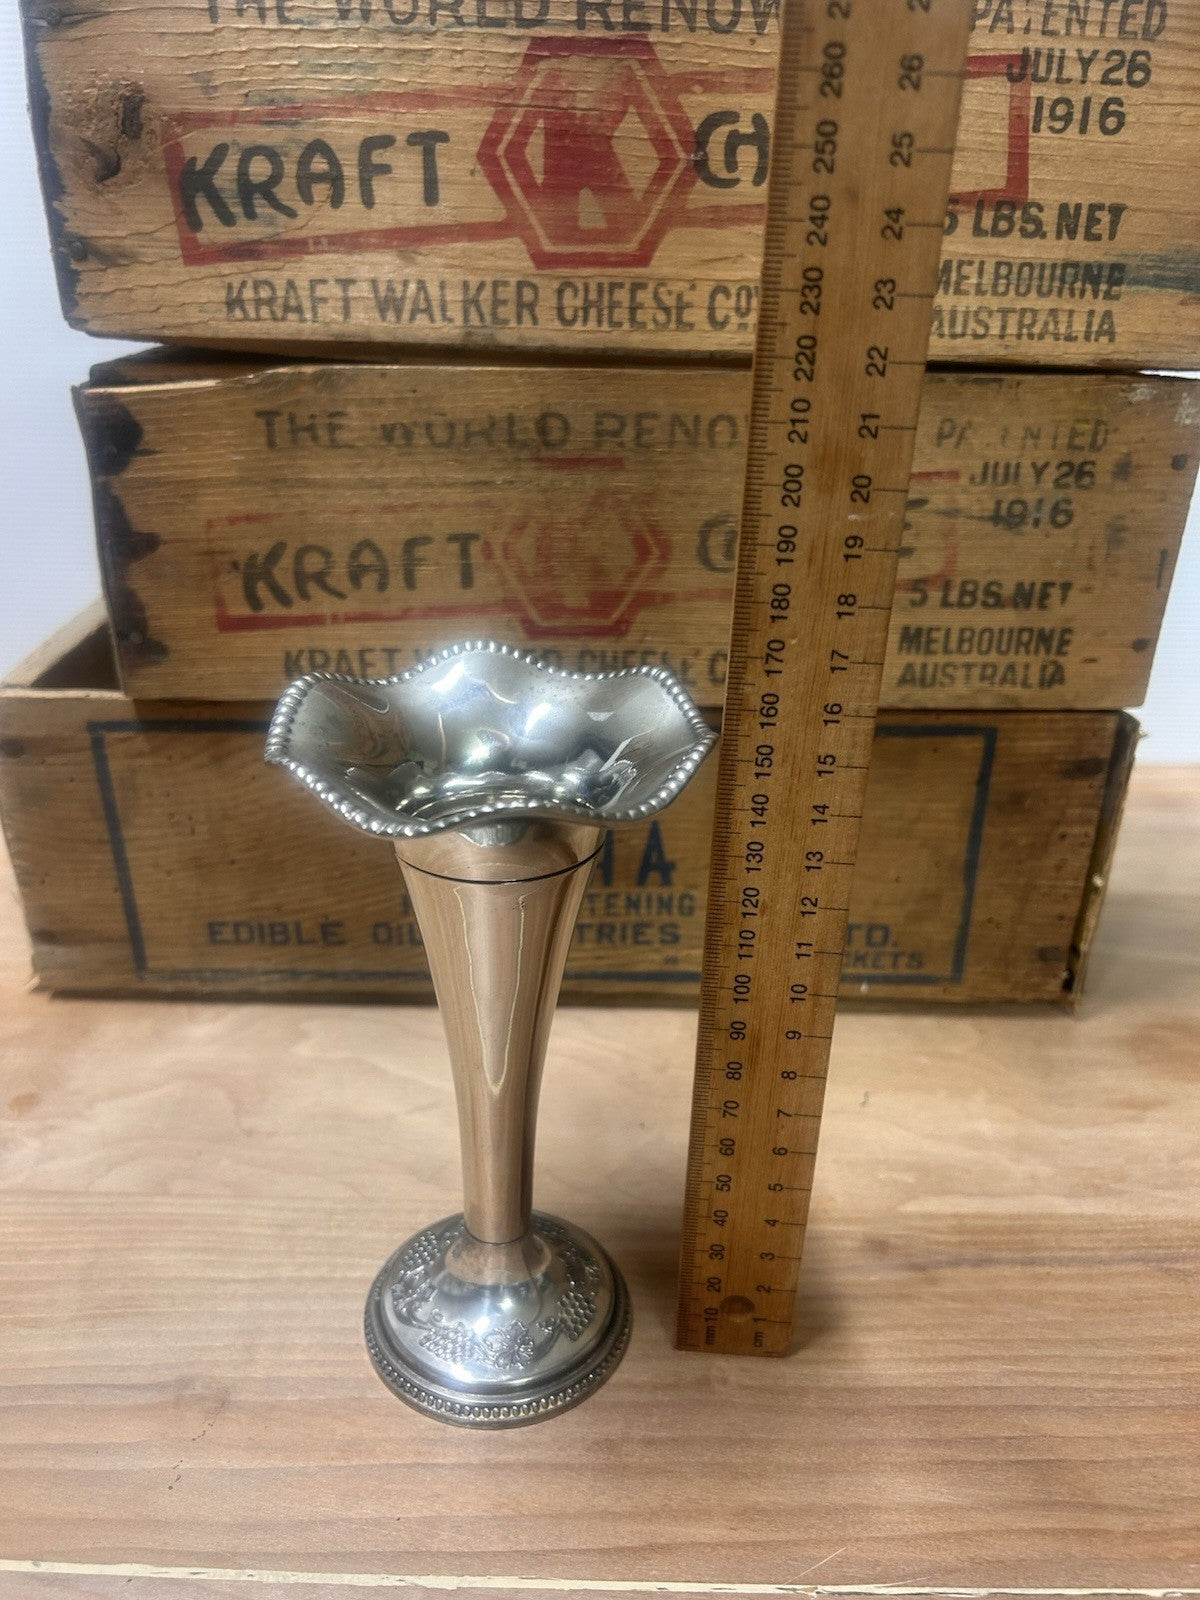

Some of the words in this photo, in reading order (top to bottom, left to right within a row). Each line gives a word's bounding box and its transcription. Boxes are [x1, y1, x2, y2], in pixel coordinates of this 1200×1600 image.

[336, 0, 551, 29] WORLD
[819, 40, 847, 99] 260
[898, 53, 925, 92] 26
[1006, 47, 1099, 86] JULY
[1101, 49, 1152, 88] 26
[1031, 95, 1127, 136] 1916
[812, 119, 839, 174] 250
[889, 130, 914, 168] 25
[179, 130, 450, 233] KRAFT
[807, 194, 831, 247] 240
[881, 207, 905, 241] 24
[1055, 202, 1128, 242] NET
[225, 278, 356, 324] KRAFT
[371, 278, 540, 327] WALKER
[556, 280, 697, 330] CHEESE
[800, 266, 824, 316] 230
[872, 277, 896, 311] 23
[932, 304, 1116, 343] AUSTRALIA
[793, 334, 818, 382] 220
[865, 346, 889, 378] 22
[255, 410, 351, 448] THE
[788, 398, 811, 444] 210
[858, 412, 880, 440] 21
[781, 464, 804, 508] 200
[850, 474, 872, 504] 20
[1053, 460, 1096, 490] 26
[776, 525, 798, 566] 190
[843, 535, 864, 562] 19
[243, 532, 481, 612] KRAFT
[770, 583, 791, 623] 180
[836, 593, 857, 619] 18
[910, 577, 929, 607] 5
[1013, 580, 1073, 610] NET
[898, 624, 1074, 656] MELBOURNE
[764, 638, 786, 677] 170
[830, 649, 850, 674] 17
[897, 660, 1066, 689] AUSTRALIA
[759, 692, 780, 730] 160
[823, 702, 843, 727] 16
[754, 744, 774, 780] 150
[816, 753, 836, 778] 15
[750, 793, 770, 828] 140
[811, 803, 829, 826] 14
[745, 841, 765, 874] 130
[805, 850, 824, 872] 13
[741, 886, 761, 919] 120
[800, 896, 819, 917] 12
[207, 919, 346, 947] EDIBLE
[737, 929, 756, 960] 110
[796, 941, 813, 960] 11
[733, 974, 751, 1004] 100
[789, 983, 808, 1003] 10
[729, 1020, 748, 1041] 90
[785, 1030, 802, 1040] 9
[725, 1061, 744, 1081] 80
[781, 1069, 797, 1081] 8
[722, 1100, 740, 1118] 70
[776, 1109, 794, 1119] 7
[719, 1137, 736, 1157] 60
[772, 1146, 789, 1157] 6
[716, 1174, 732, 1192] 50
[768, 1182, 784, 1192] 5
[713, 1209, 729, 1227] 40
[765, 1218, 780, 1227] 4
[709, 1243, 725, 1260] 30
[760, 1252, 775, 1260] 3
[706, 1276, 721, 1293] 20
[756, 1284, 771, 1293] 2
[704, 1306, 719, 1323] 10
[705, 1325, 716, 1345] mm
[753, 1331, 765, 1348] cm
